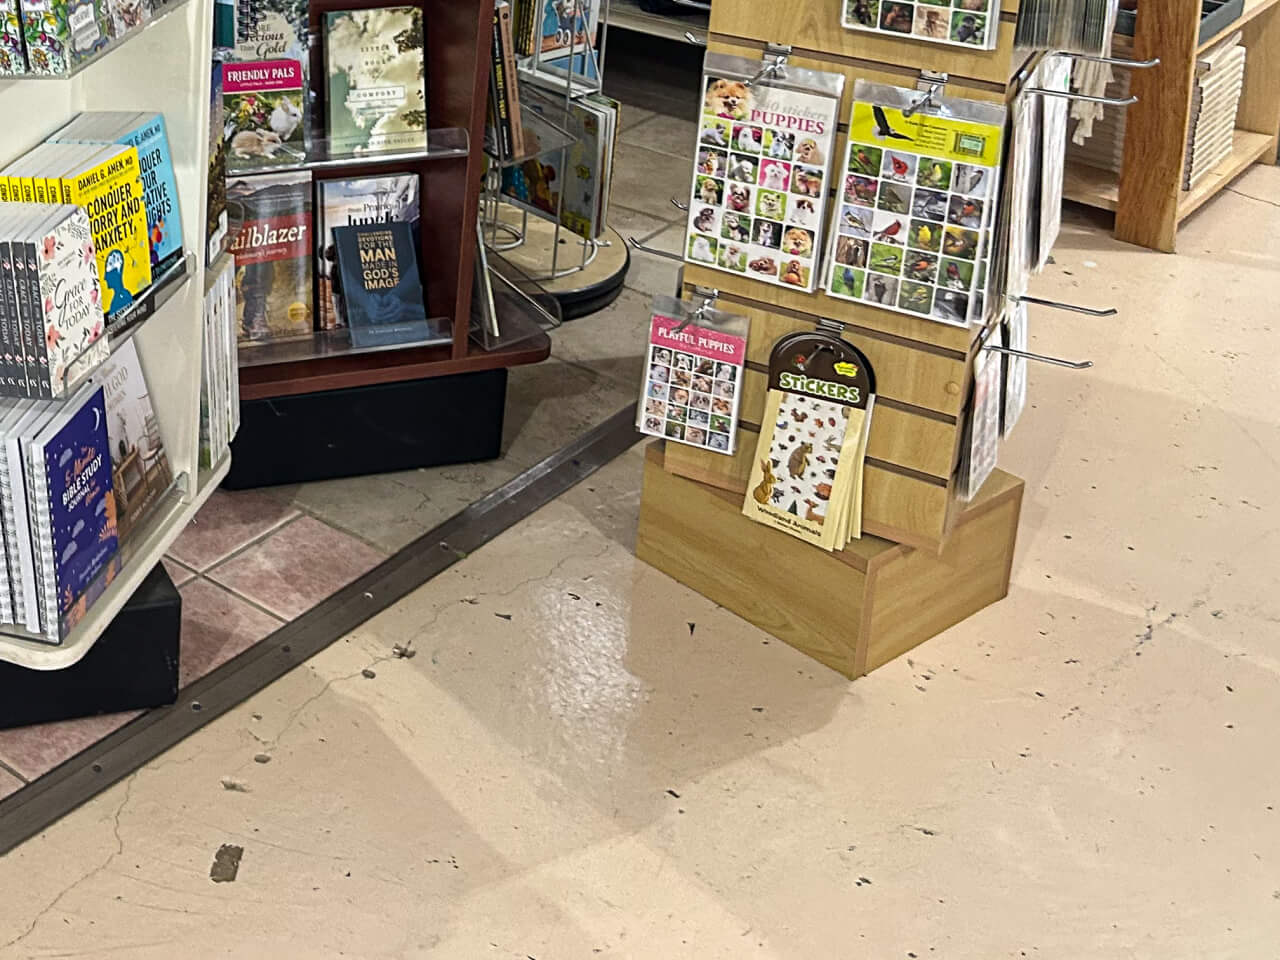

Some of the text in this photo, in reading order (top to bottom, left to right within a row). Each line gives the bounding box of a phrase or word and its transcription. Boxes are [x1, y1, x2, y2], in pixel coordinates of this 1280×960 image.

[255, 40, 288, 59] Gold
[227, 66, 295, 82] FRIENDLY PALS
[749, 108, 826, 136] PUPPIES
[78, 172, 100, 192] DANIEL
[86, 182, 133, 220] CONQUER
[120, 196, 141, 222] AND
[359, 247, 397, 263] MAN
[362, 267, 400, 281] GOD'S
[54, 277, 87, 328] Grace
[64, 303, 91, 331] TODAY
[657, 326, 736, 356] PLAYFUL PUPPIES
[80, 452, 103, 486] STUDY
[792, 521, 823, 539] Animals
